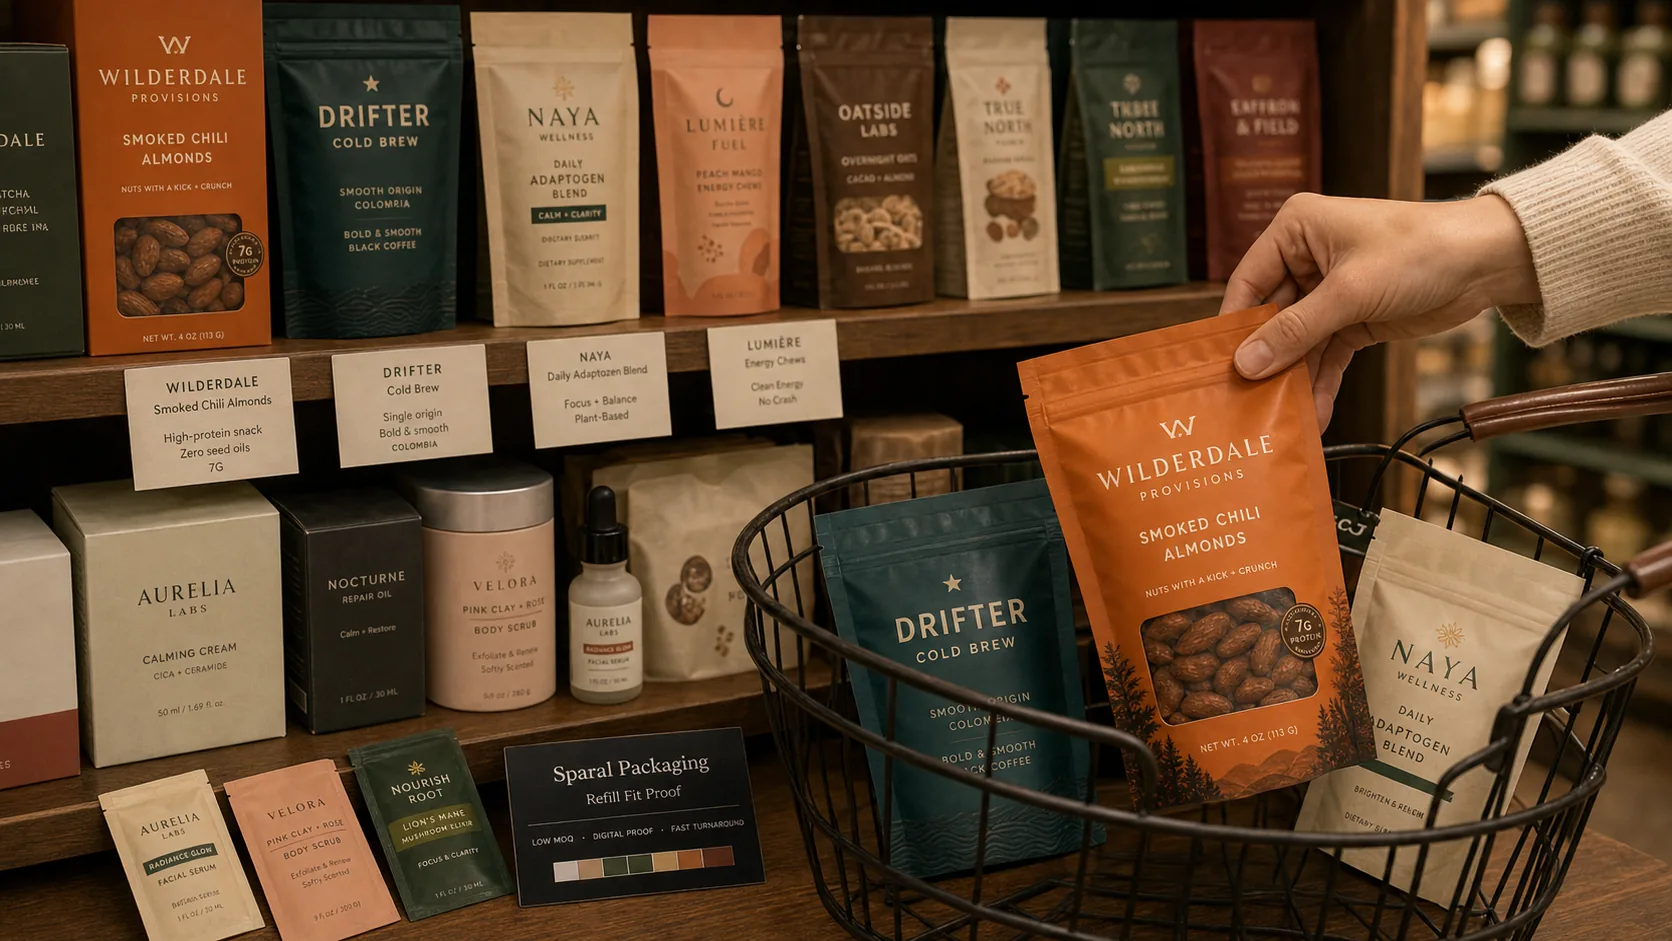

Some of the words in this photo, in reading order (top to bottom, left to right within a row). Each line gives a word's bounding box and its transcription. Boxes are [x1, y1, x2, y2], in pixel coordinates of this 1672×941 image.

[99, 69, 247, 86] WILDERDALE
[132, 93, 219, 103] PROVISIONS
[318, 104, 430, 128] DRIFTER
[838, 102, 912, 121] OATSIDE
[983, 101, 1024, 116] TRUE
[528, 107, 600, 127] NAYA
[686, 114, 765, 133] LUMIÈRE
[860, 123, 898, 138] LABS
[984, 119, 1033, 135] NORTH
[1109, 121, 1164, 139] NORTH
[1254, 118, 1300, 136] FIELD
[123, 133, 185, 146] SMOKED
[191, 132, 228, 144] CHILI
[332, 137, 372, 149] COLD
[380, 136, 418, 148] BREW
[539, 133, 594, 142] WELLNESS
[712, 140, 747, 150] FUEL
[142, 152, 212, 165] ALMONDS
[554, 160, 583, 169] DAILY
[121, 185, 141, 193] NUTS
[144, 184, 164, 192] WITH
[200, 182, 232, 190] CRUNCH
[530, 173, 605, 186] ADAPTOGEN
[340, 187, 384, 196] SMOOTH
[388, 186, 422, 195] ORIGIN
[552, 188, 587, 199] BLEND
[538, 211, 561, 220] CALM
[571, 210, 601, 218] CLARITY
[344, 230, 371, 239] BOLD
[384, 228, 422, 237] SMOOTH
[349, 243, 381, 252] BLACK
[383, 241, 416, 250] COFFEE
[143, 334, 159, 343] NET
[185, 332, 197, 341] OZ
[747, 336, 802, 351] LUMIÈRE
[580, 350, 612, 363] NAYA
[745, 358, 774, 369] Energy
[383, 363, 442, 378] DRIFTER
[547, 371, 571, 383] Daily
[623, 365, 648, 376] Blend
[166, 376, 259, 394] WILDERDALE
[387, 384, 411, 396] Cold
[414, 383, 440, 394] Brew
[751, 382, 775, 392] Clean
[776, 380, 804, 390] Energy
[154, 401, 199, 415] Smoked
[201, 399, 225, 411] Chili
[227, 395, 272, 409] Almonds
[564, 399, 592, 409] Focus
[602, 395, 637, 406] Balance
[758, 397, 772, 406] No
[773, 395, 798, 405] Crash
[383, 411, 413, 423] Single
[415, 408, 443, 421] origin
[574, 410, 630, 424] Plant-Based
[164, 428, 231, 445] High-protein
[233, 425, 263, 437] snack
[379, 427, 402, 438] Bold
[404, 427, 411, 436] &
[414, 423, 449, 436] smooth
[180, 448, 204, 459] Zero
[206, 444, 230, 456] seed
[233, 443, 251, 453] oils
[391, 440, 438, 452] COLOMBIA
[208, 462, 224, 473] 7G
[1096, 434, 1274, 491] WILDERDALE
[1139, 468, 1244, 502] PROVISIONS
[1139, 517, 1209, 545] SMOKED
[1216, 506, 1261, 526] CHILI
[1164, 531, 1247, 562] ALMONDS
[328, 570, 406, 591] NOCTURNE
[473, 575, 537, 592] VELORA
[1145, 585, 1170, 598] NUTS
[1171, 578, 1196, 591] WITH
[1198, 576, 1205, 585] A
[1206, 571, 1229, 582] KICK
[1238, 560, 1278, 575] CRUNCH
[137, 578, 236, 606] AURELIA
[342, 593, 374, 604] REPAIR
[377, 590, 392, 599] OIL
[169, 604, 207, 618] LABS
[462, 605, 487, 614] PINK
[491, 603, 516, 614] CLAY
[526, 597, 546, 609] ROSE
[474, 625, 504, 635] BODY
[507, 620, 537, 633] SCRUB
[586, 616, 632, 628] AURELIA
[895, 598, 1028, 644] DRIFTER
[1294, 619, 1312, 633] 7G
[339, 629, 360, 639] Calm
[368, 624, 397, 635] Restore
[599, 629, 619, 637] LABS
[142, 649, 196, 665] CALMING
[199, 642, 237, 656] CREAM
[916, 646, 961, 664] COLD
[969, 636, 1016, 655] BREW
[153, 671, 175, 680] CICA
[184, 662, 228, 675] CERAMIDE
[1390, 639, 1478, 691] NAYA
[1397, 671, 1463, 702] WELLNESS
[170, 706, 181, 715] ml
[188, 702, 204, 712] 1.69
[929, 704, 980, 719] SMOO
[1398, 705, 1434, 726] DAILY
[992, 740, 1036, 756] SMOOTH
[1200, 742, 1219, 753] NET
[1242, 736, 1249, 744] 4
[1250, 732, 1265, 743] OZ
[1267, 728, 1285, 740] (113
[1382, 740, 1425, 763] BLEND
[553, 761, 614, 786] Sparal
[618, 755, 709, 777] Packaging
[990, 755, 1032, 771] COFFEE
[391, 773, 451, 796] NOURISH
[408, 788, 443, 804] ROOT
[586, 791, 621, 805] Refill
[625, 789, 643, 802] Fit
[646, 785, 682, 801] Proof
[267, 798, 326, 821] VELORA
[140, 812, 200, 837] AURELIA
[402, 815, 436, 832] LION'S
[438, 809, 466, 821] MANE
[161, 829, 186, 840] LABS
[266, 834, 289, 847] PINK
[290, 826, 313, 839] CLAY
[401, 825, 448, 845] MUSHROOM
[532, 837, 552, 847] LOW
[553, 835, 574, 845] MOQ
[593, 830, 624, 841] DIGITAL
[626, 827, 654, 837] PROOF
[671, 823, 690, 833] FAST
[693, 819, 745, 831] TURNAROUND
[283, 845, 309, 860] BODY
[312, 836, 341, 850] SCRUB
[148, 852, 189, 871] RADIANCE
[190, 846, 212, 857] GLOW
[417, 856, 443, 869] FOCUS
[451, 847, 479, 859] CLARITY
[157, 871, 187, 887] FACIAL
[189, 863, 217, 876] SERUM
